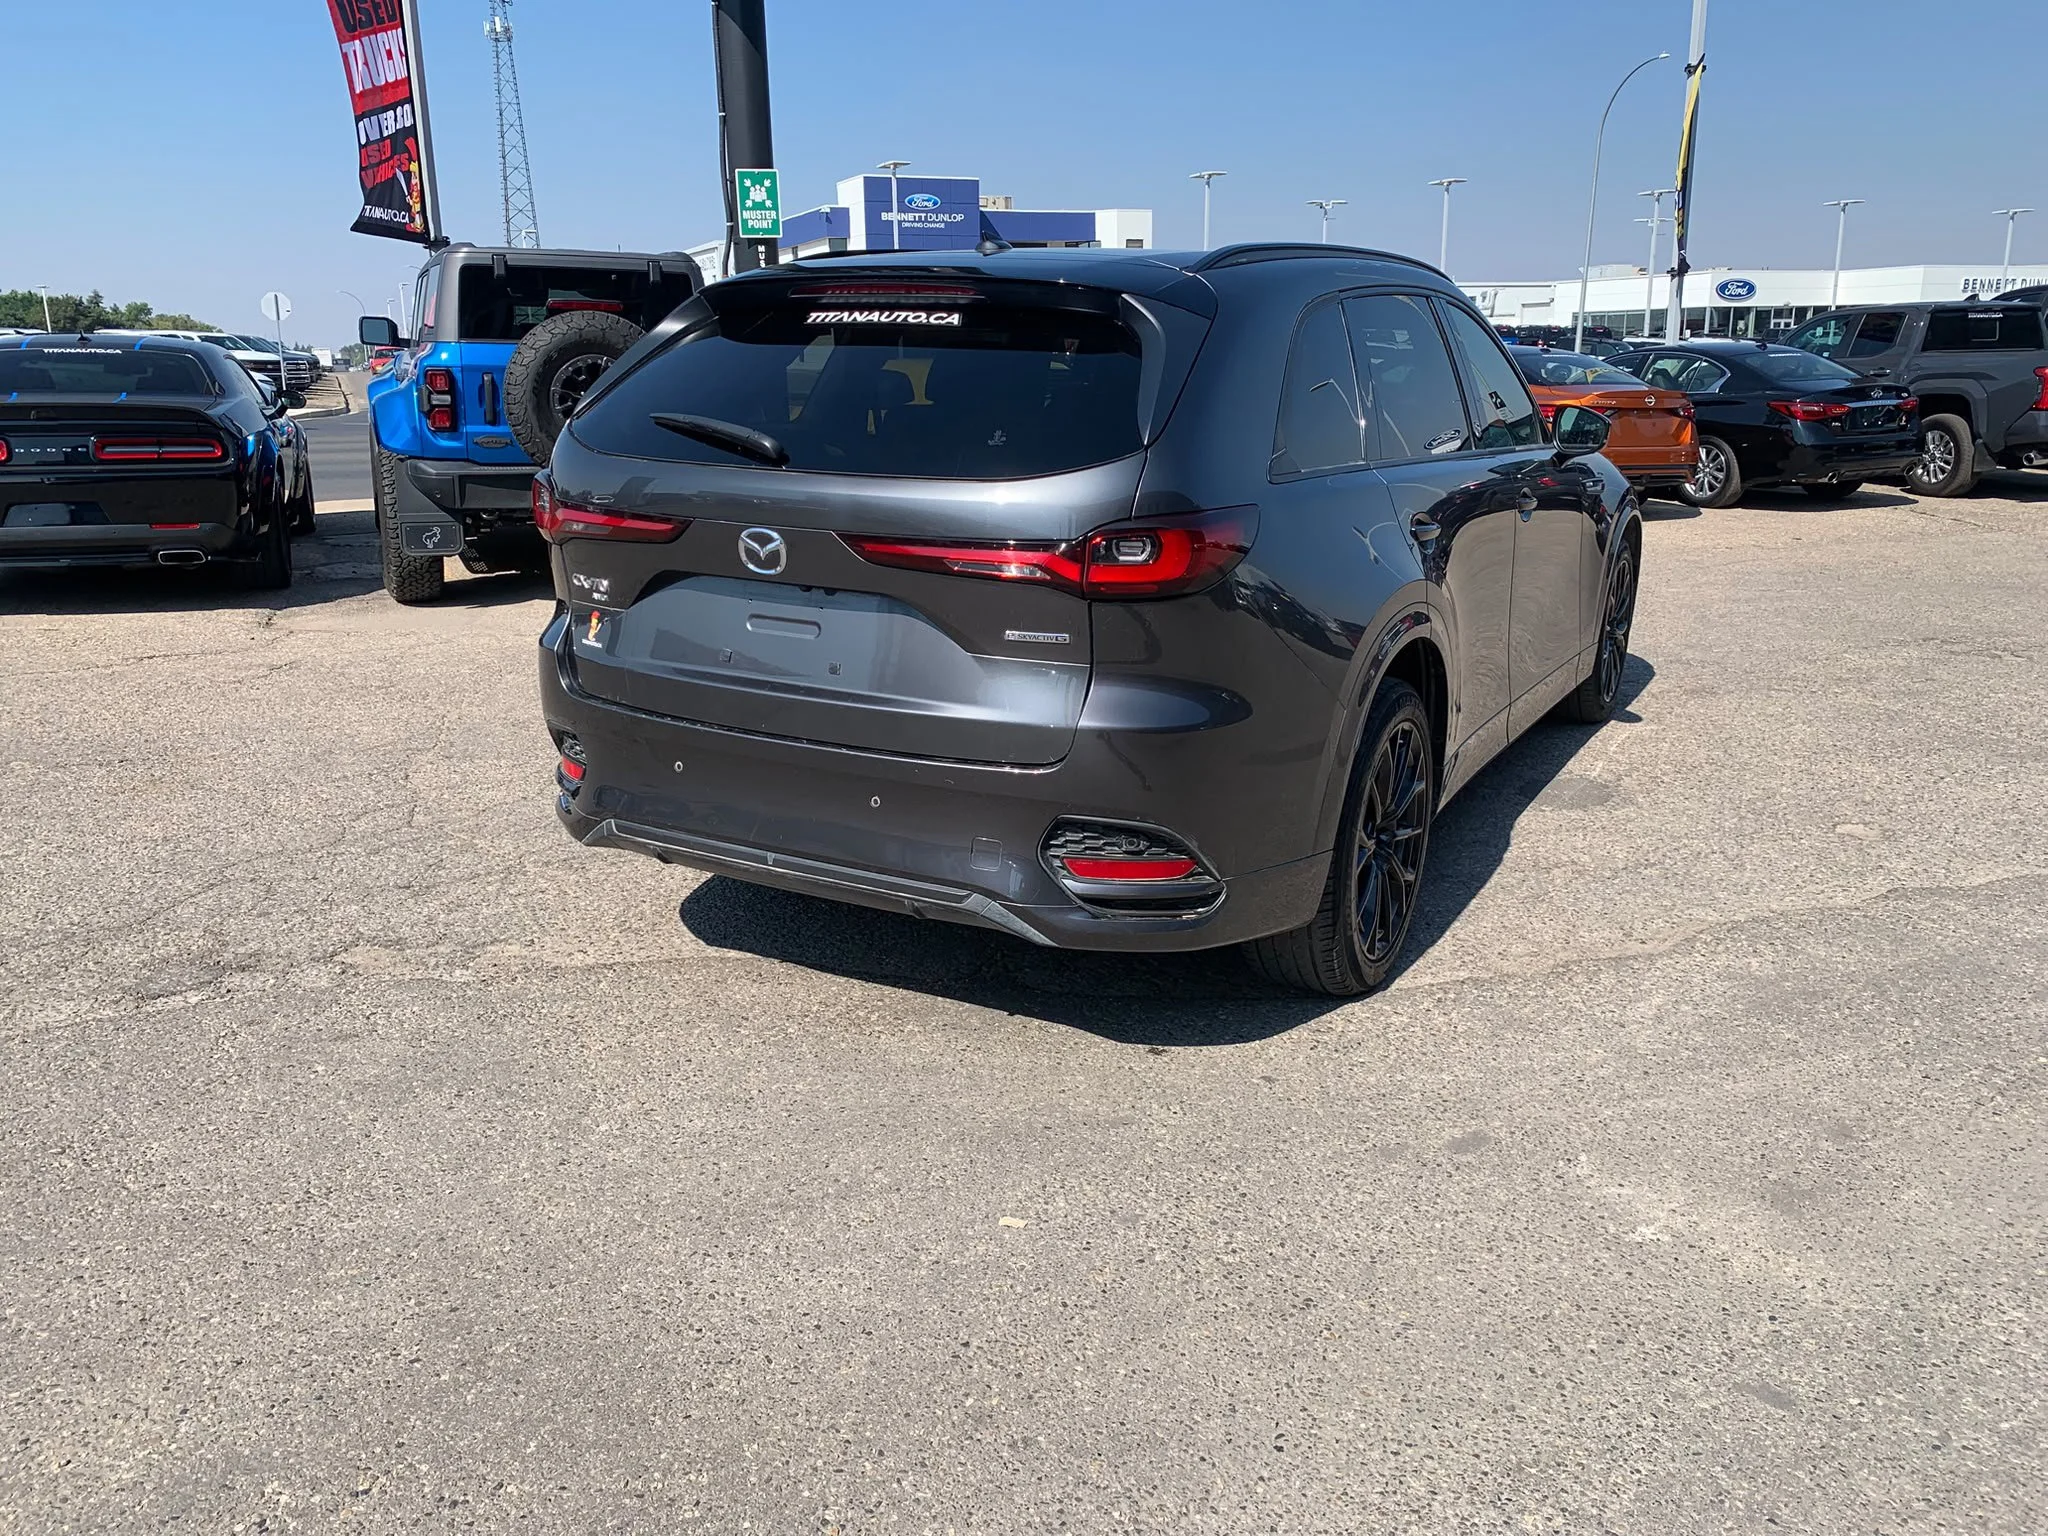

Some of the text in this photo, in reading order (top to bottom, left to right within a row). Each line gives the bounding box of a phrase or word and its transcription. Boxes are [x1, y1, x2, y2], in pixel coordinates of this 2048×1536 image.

[742, 210, 777, 220] MUSTER
[927, 213, 965, 222] DUNLOP
[747, 220, 773, 229] POINT
[1725, 281, 1749, 295] Ford
[806, 311, 961, 325] TITANAUTO.CA
